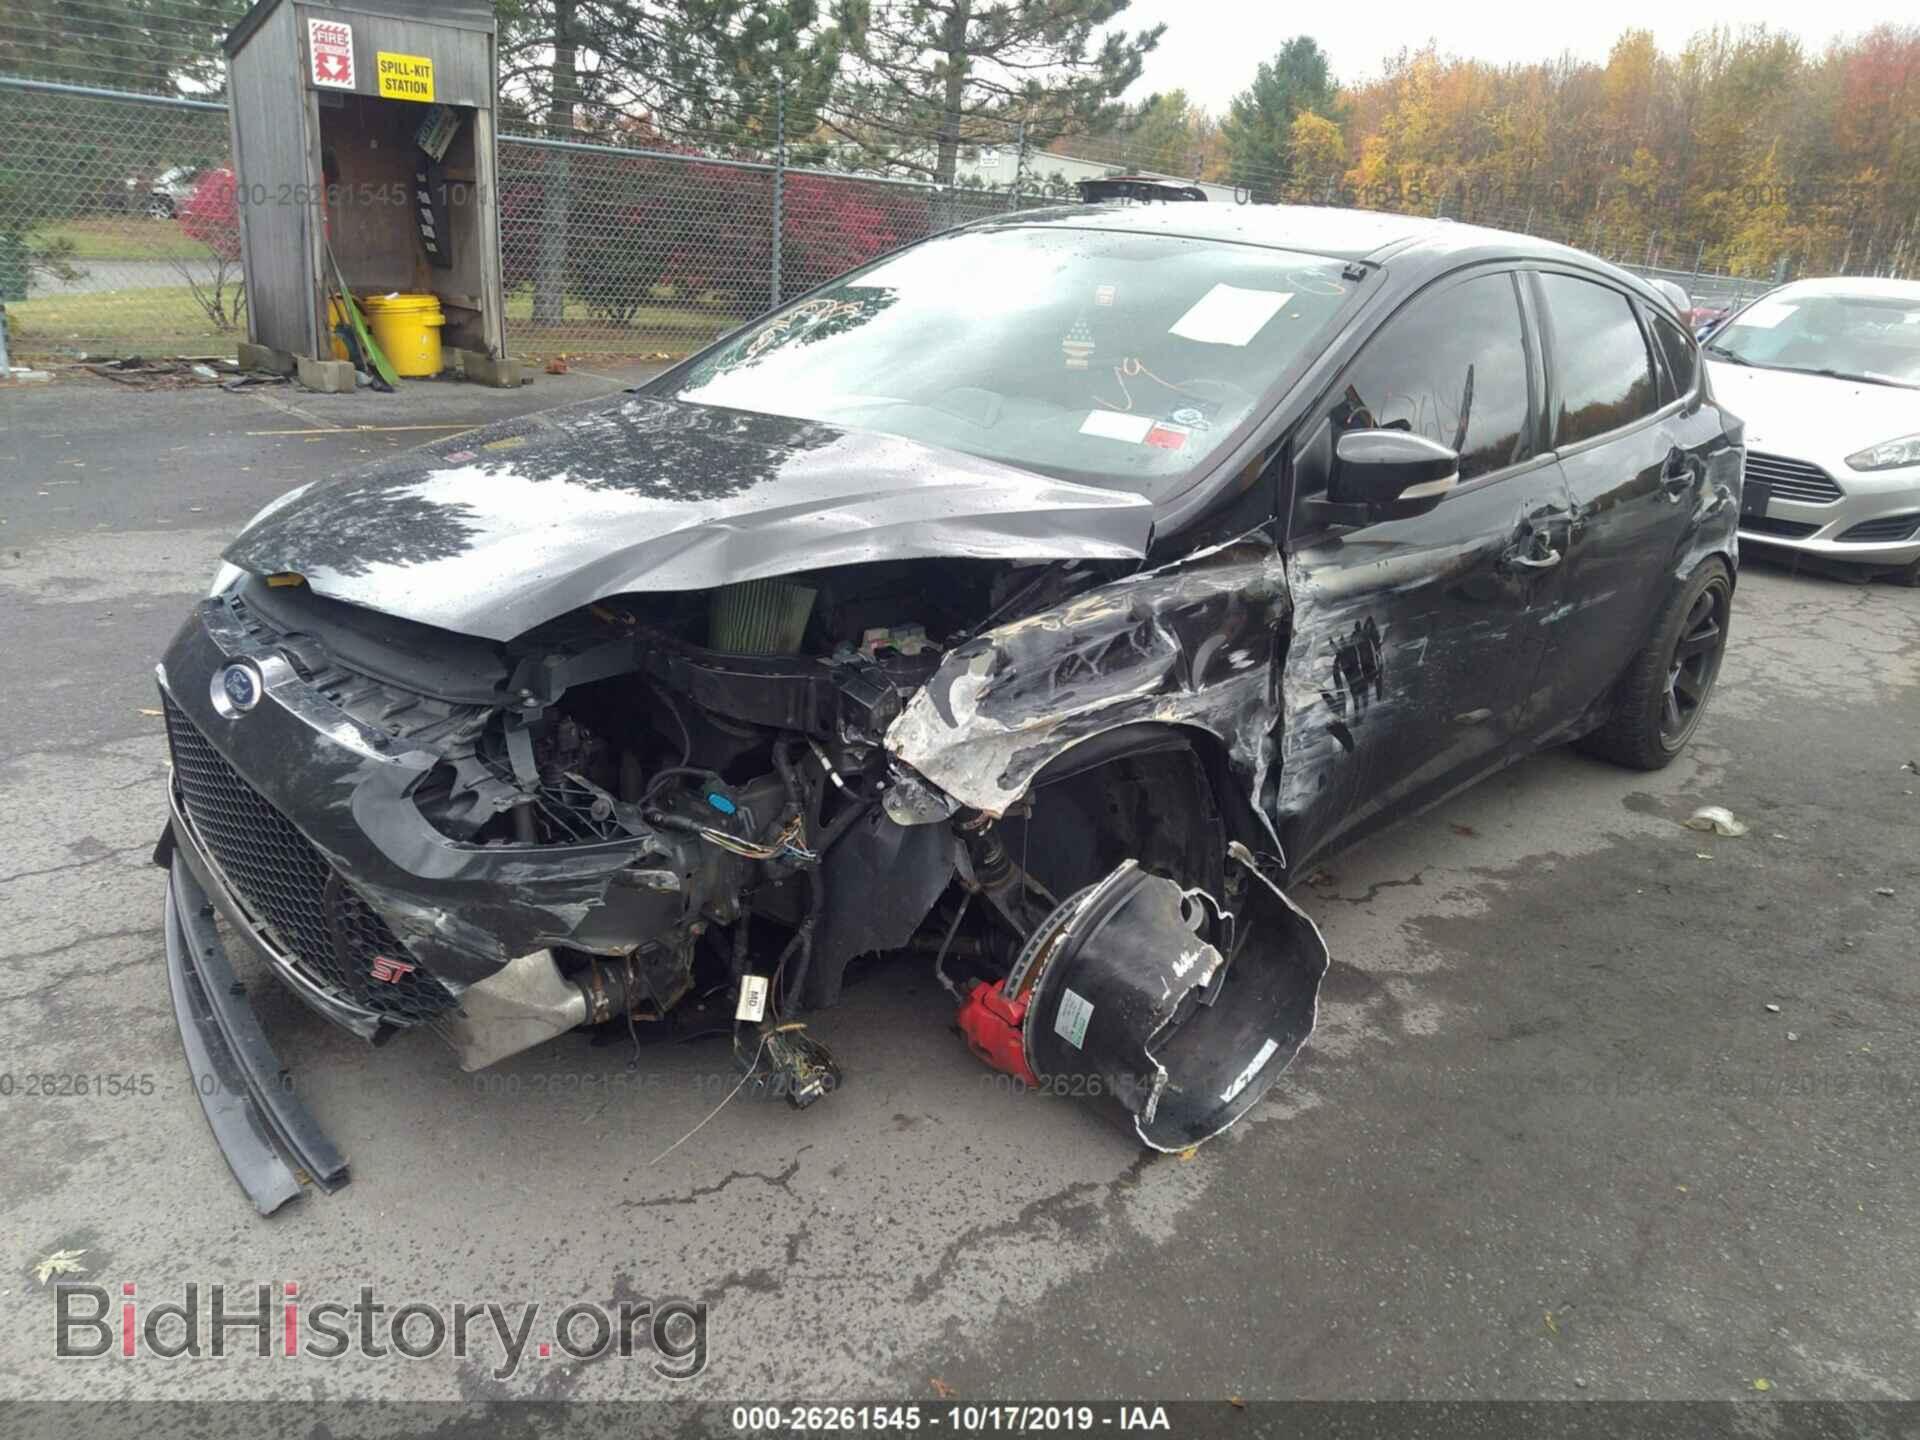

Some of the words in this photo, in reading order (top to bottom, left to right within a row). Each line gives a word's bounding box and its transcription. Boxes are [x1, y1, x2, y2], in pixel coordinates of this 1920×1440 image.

[316, 30, 346, 46] FIRE
[379, 58, 432, 79] SPILL-KIT
[384, 77, 429, 96] STATION
[370, 956, 416, 984] ST
